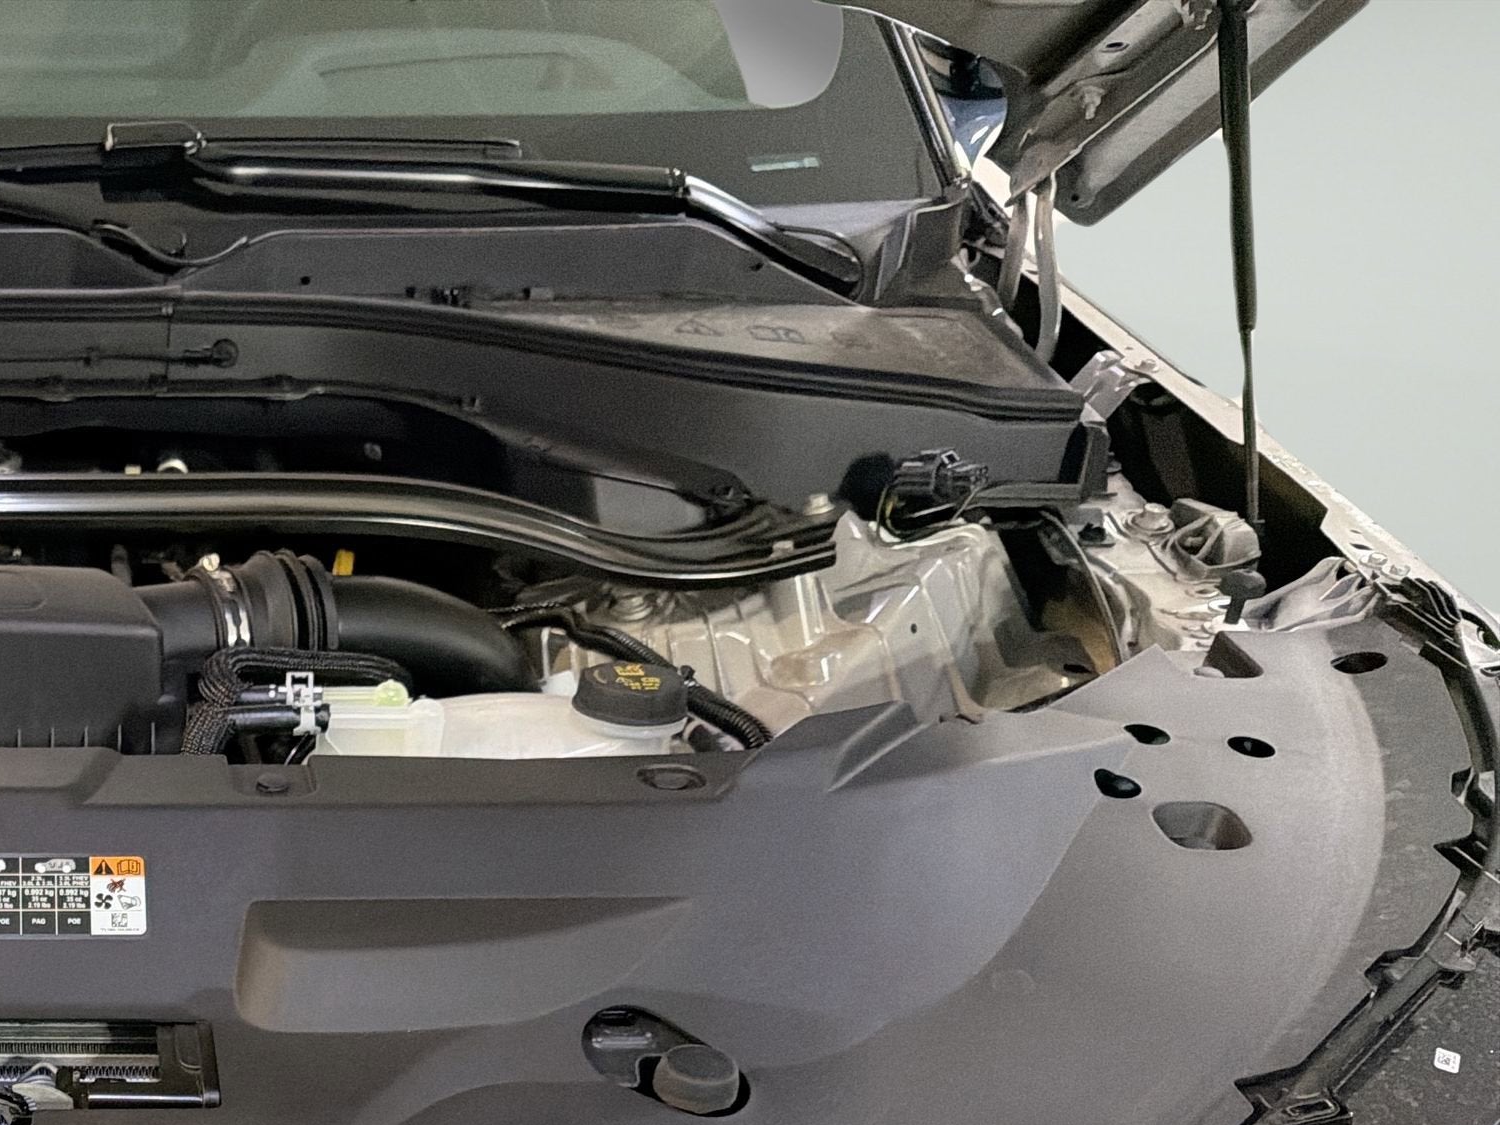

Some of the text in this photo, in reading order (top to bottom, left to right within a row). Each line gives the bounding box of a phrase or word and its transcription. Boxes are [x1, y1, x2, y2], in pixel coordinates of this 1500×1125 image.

[8, 889, 17, 897] kg
[45, 889, 54, 897] kg
[80, 889, 89, 897] kg
